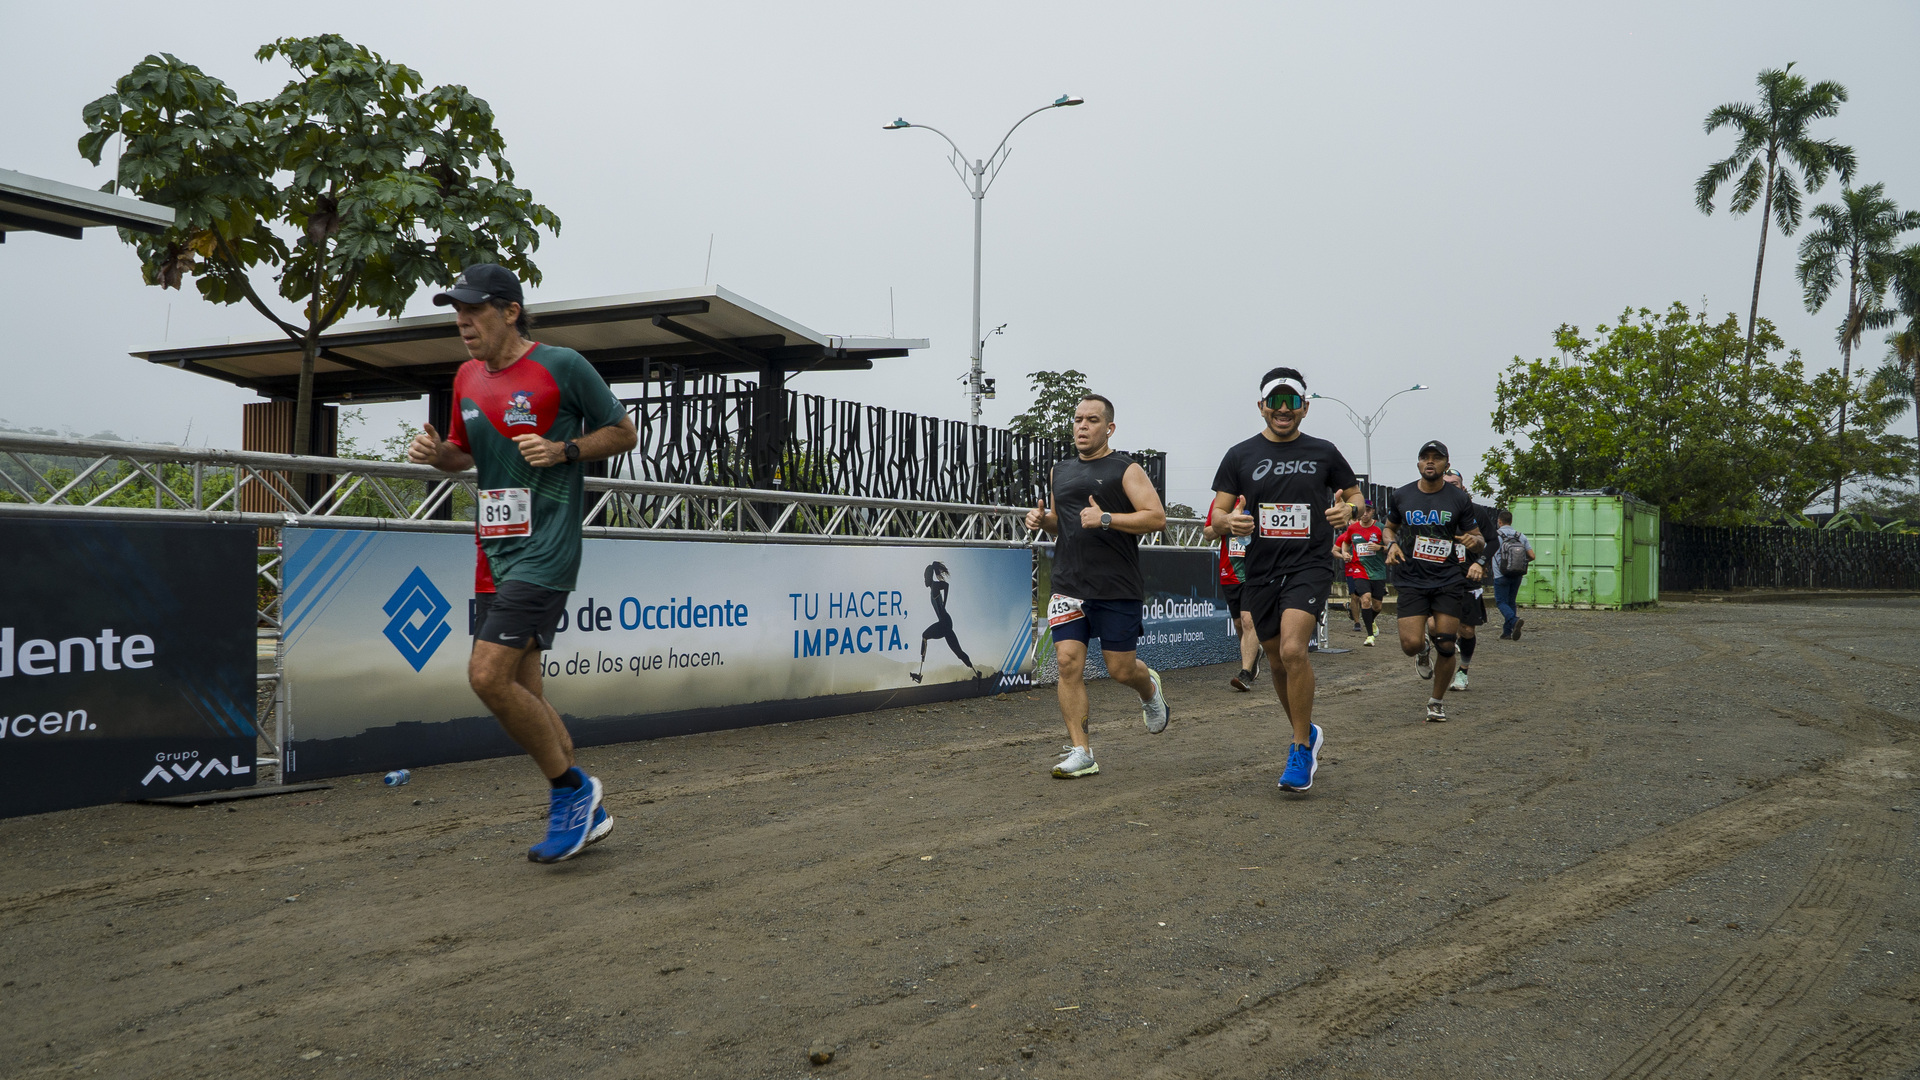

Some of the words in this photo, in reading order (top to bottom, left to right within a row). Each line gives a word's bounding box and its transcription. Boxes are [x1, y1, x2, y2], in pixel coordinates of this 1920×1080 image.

[1273, 460, 1317, 475] asics
[486, 504, 511, 522] 819
[1271, 514, 1295, 527] 921
[1406, 510, 1452, 526] I&AF
[1421, 544, 1445, 556] 1575
[577, 597, 612, 631] de
[619, 596, 748, 630] Occidente
[789, 593, 818, 620] TU
[829, 590, 908, 620] HACER,
[1052, 602, 1070, 614] 453
[1150, 599, 1164, 619] de
[1165, 598, 1214, 618] Occidente
[794, 624, 909, 658] IMPACTA.
[1146, 630, 1156, 645] de
[1157, 630, 1168, 643] los
[1169, 633, 1182, 646] que
[566, 652, 590, 675] de
[597, 651, 623, 673] los
[629, 655, 663, 676] que
[668, 647, 724, 668] hacen.
[999, 674, 1030, 686] AVAL
[0, 709, 97, 739] cen.
[155, 750, 199, 762] Grupo
[141, 755, 250, 786] AVAL
